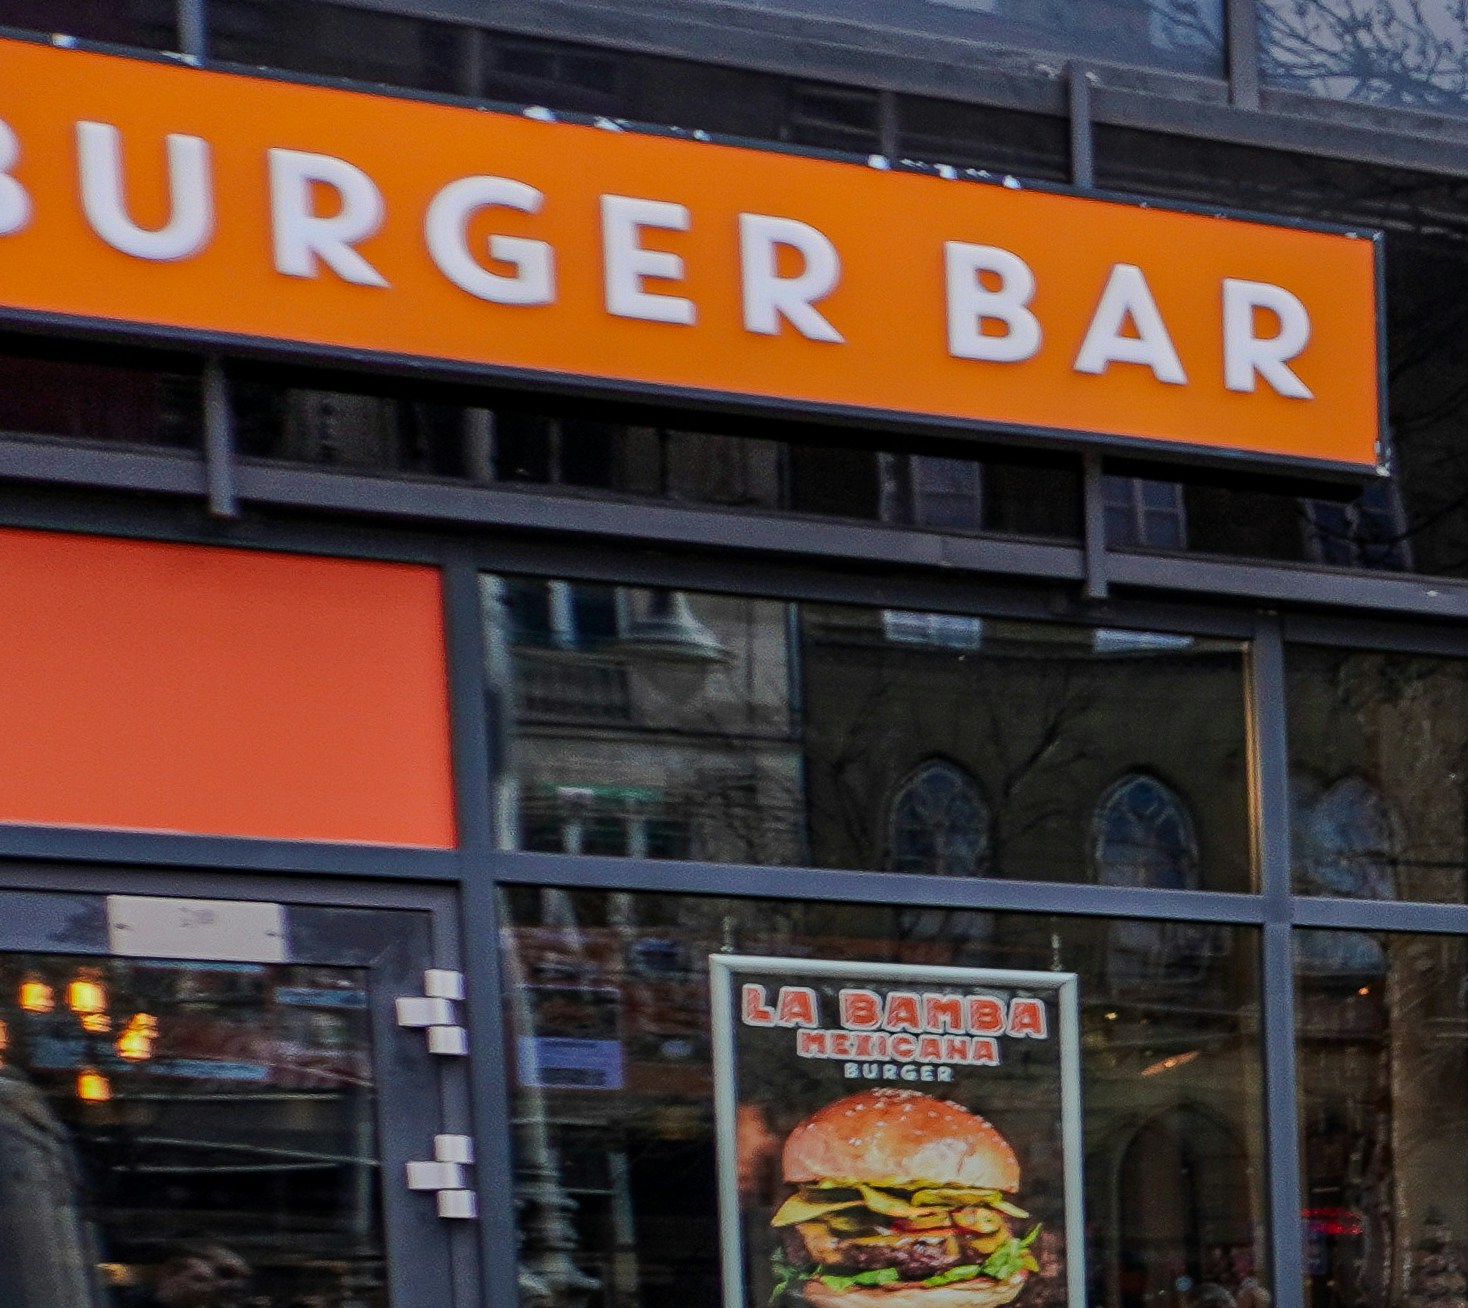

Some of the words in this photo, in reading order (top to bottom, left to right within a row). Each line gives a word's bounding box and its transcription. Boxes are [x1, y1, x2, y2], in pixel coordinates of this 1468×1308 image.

[944, 241, 1313, 399] BAR
[742, 984, 819, 1028] LA
[839, 989, 1047, 1040] BAMBA
[796, 1029, 1000, 1067] MEXICANA
[844, 1063, 953, 1082] BURGER
